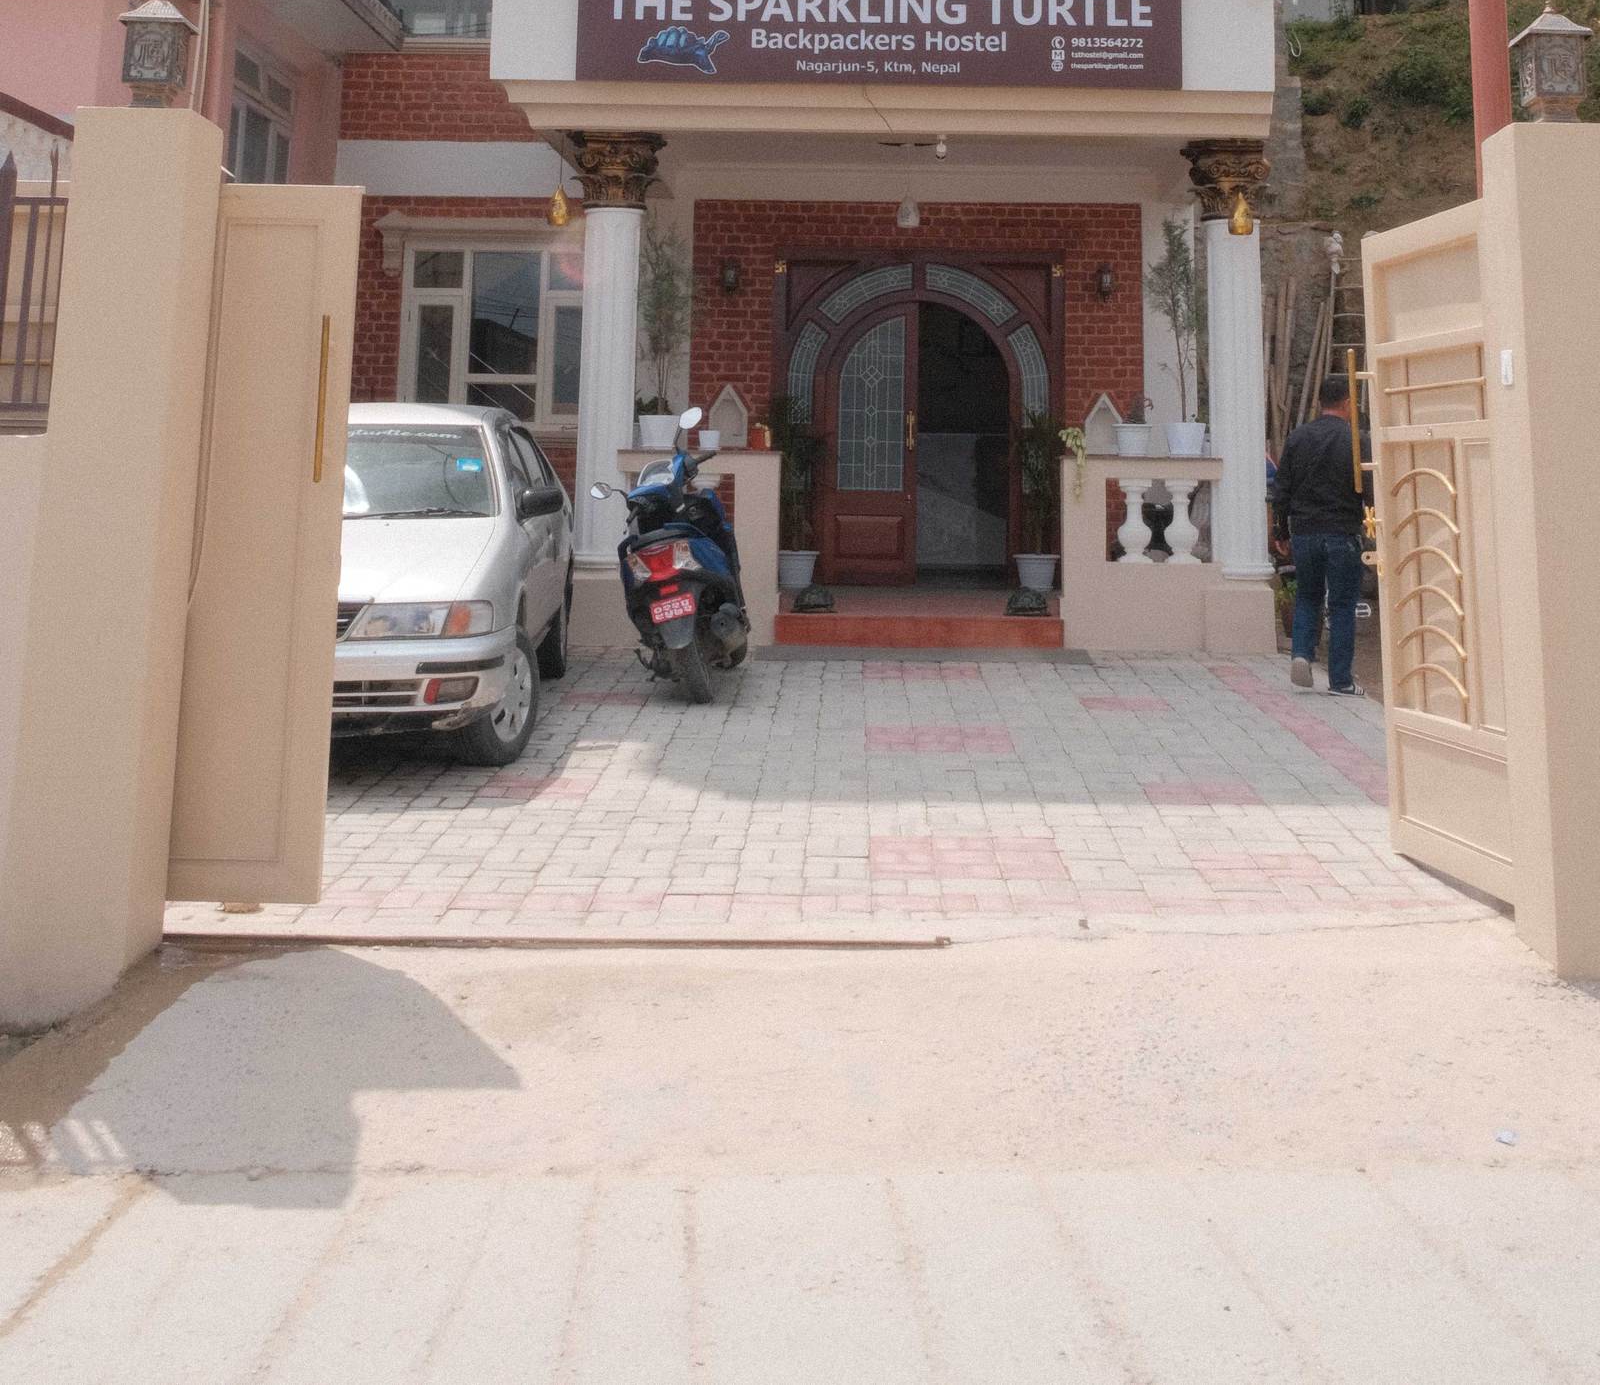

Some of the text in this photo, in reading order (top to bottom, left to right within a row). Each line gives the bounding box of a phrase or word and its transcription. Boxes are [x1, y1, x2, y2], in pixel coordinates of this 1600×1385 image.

[751, 28, 1007, 54] Backpackers Hostel
[1071, 38, 1144, 48] 9813564272
[796, 60, 960, 74] Nagarjun-5, Ktm, Nepal
